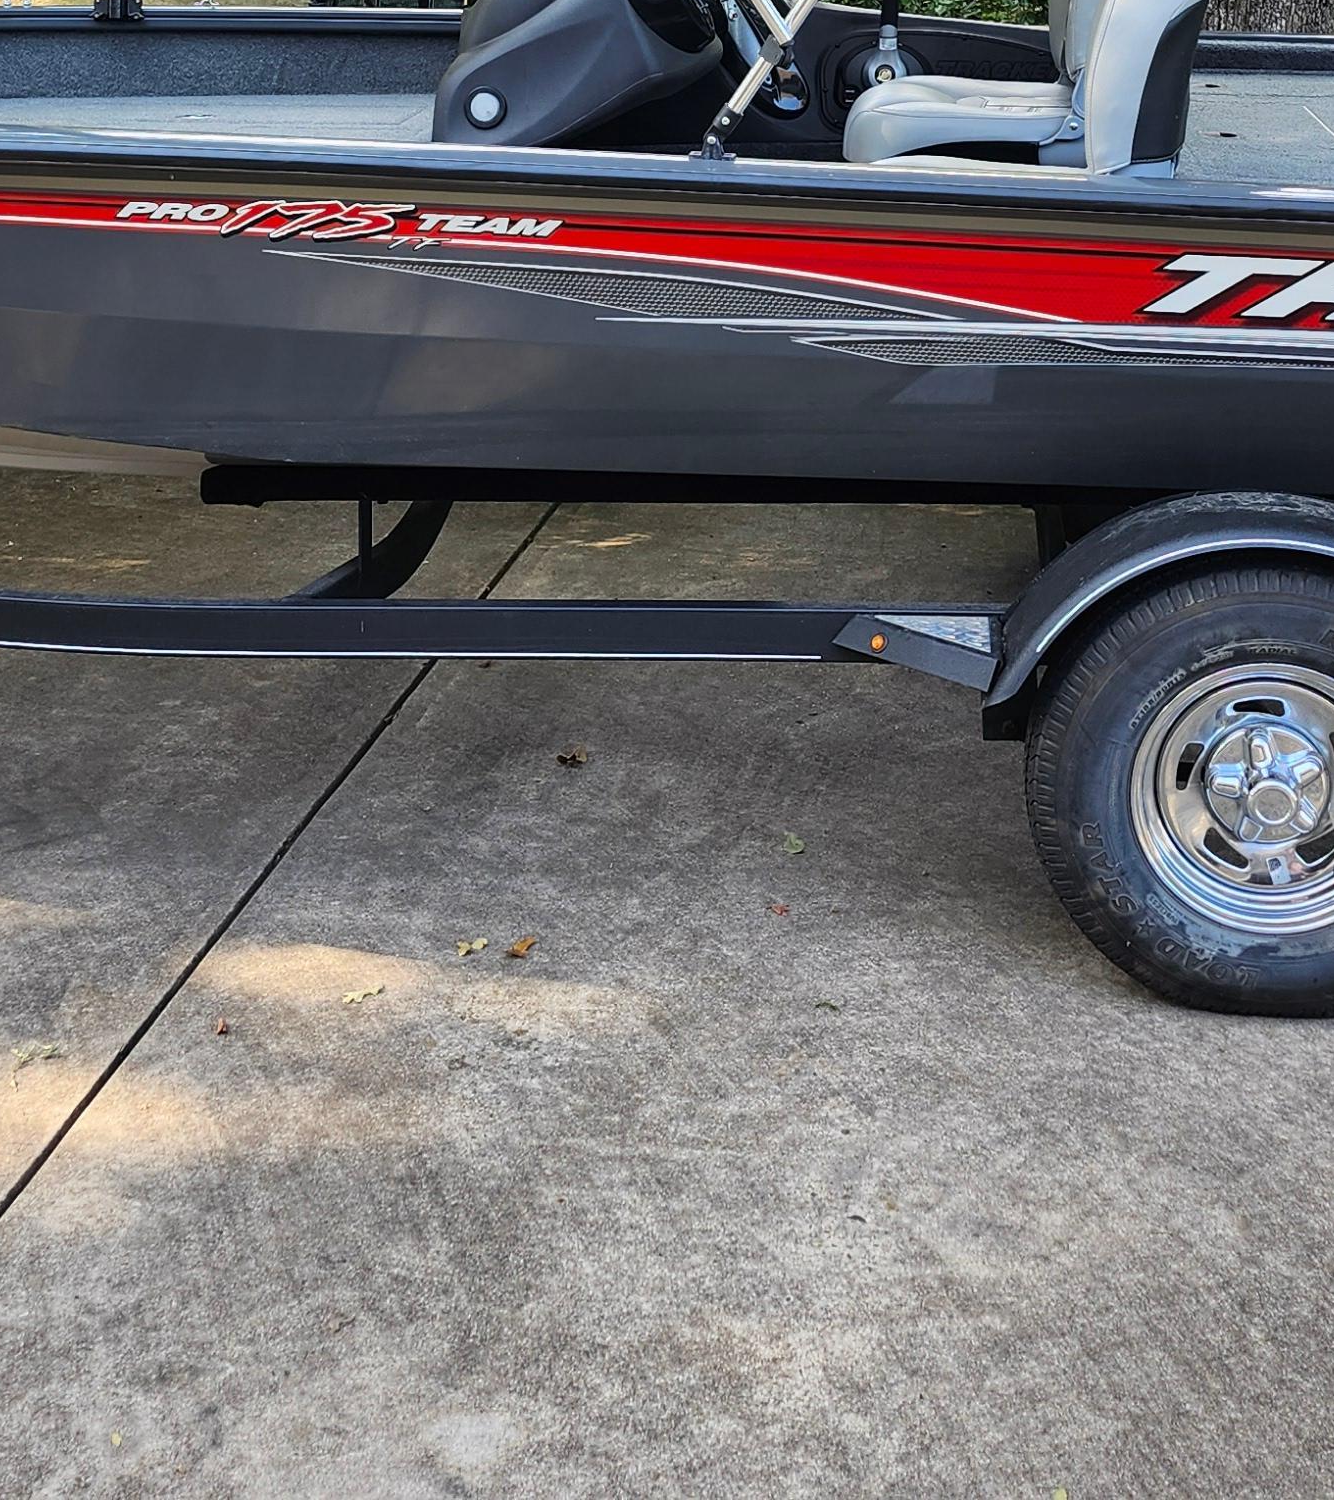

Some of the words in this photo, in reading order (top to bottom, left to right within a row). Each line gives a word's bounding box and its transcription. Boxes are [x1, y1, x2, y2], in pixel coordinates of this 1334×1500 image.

[116, 202, 229, 222] PRO
[219, 200, 416, 240] 175
[418, 213, 564, 238] TEAM
[387, 235, 453, 250] TF
[1247, 644, 1299, 655] RADIAL
[1079, 822, 1139, 915] STAR
[1155, 936, 1262, 988] LOAD
